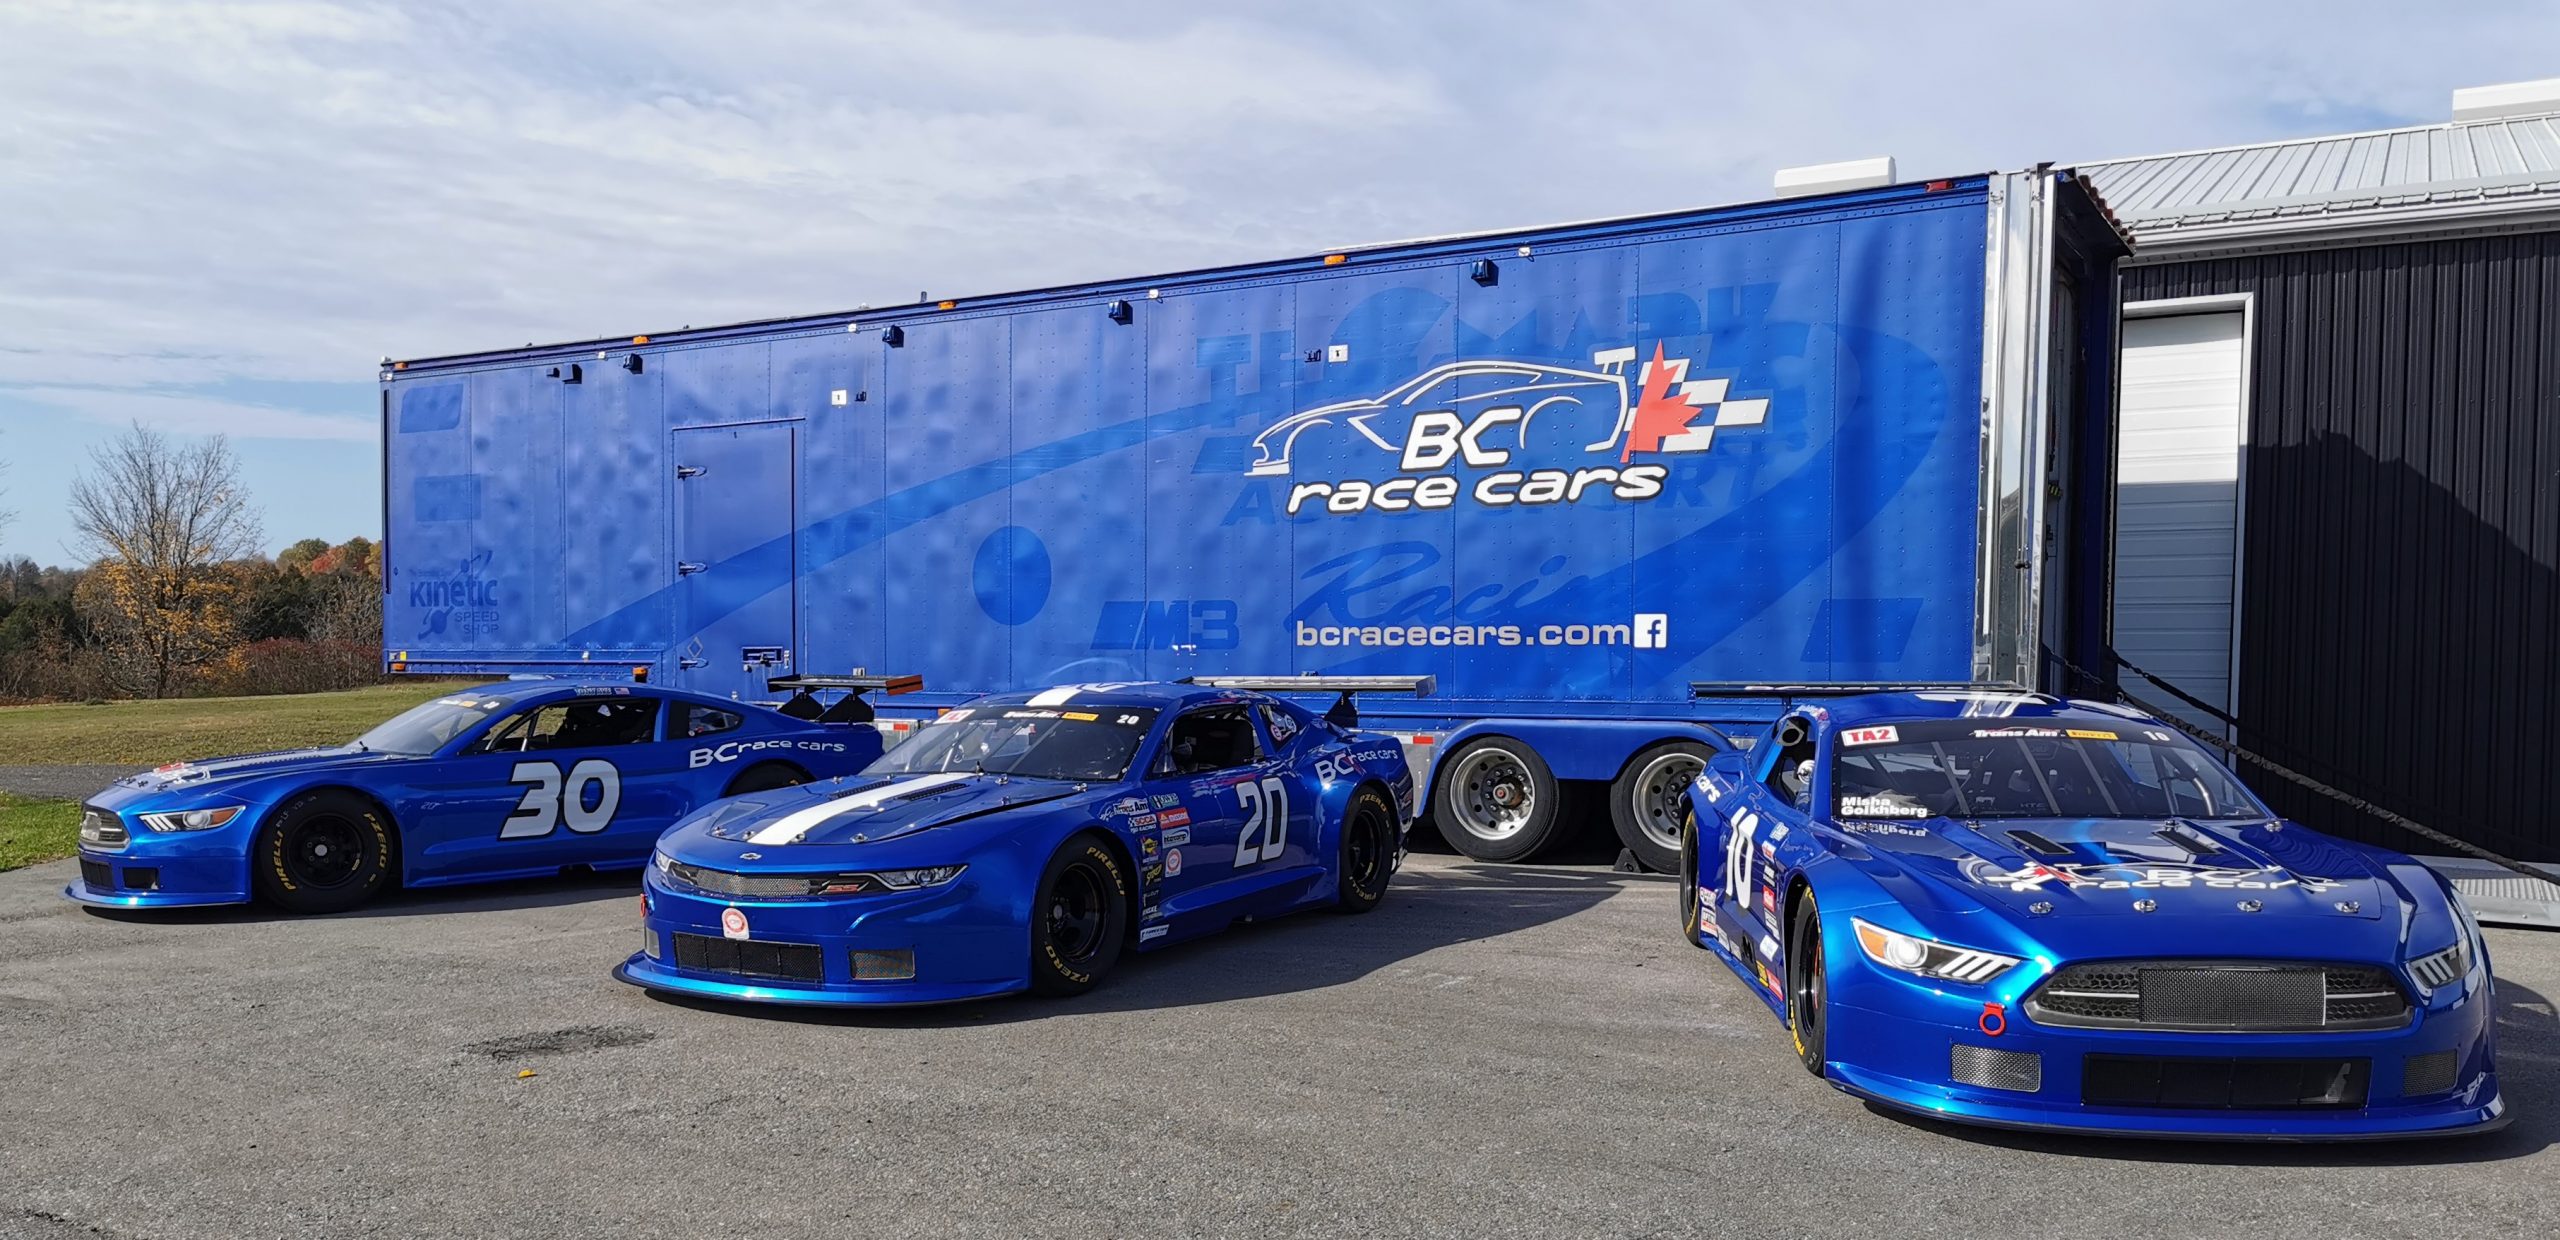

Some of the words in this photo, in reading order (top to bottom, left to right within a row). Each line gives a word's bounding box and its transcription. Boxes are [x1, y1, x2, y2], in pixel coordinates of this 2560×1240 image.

[1401, 407, 1522, 471] BC
[1286, 476, 1459, 514] race
[1474, 464, 1667, 506] cars
[454, 610, 500, 622] SPEED
[463, 624, 500, 634] SHOP
[1296, 619, 1631, 647] bcracecars.com
[1116, 714, 1140, 725] 20
[1973, 728, 2022, 738] Trans
[1848, 729, 1892, 743] TA2
[2143, 730, 2171, 742] 10
[689, 742, 738, 769] BC
[738, 740, 793, 754] race
[797, 740, 845, 752] cars
[1315, 753, 1354, 783] BC
[1348, 749, 1377, 765] race
[1377, 749, 1399, 760] cars
[499, 759, 620, 839] 30
[1134, 800, 1148, 811] Am
[1841, 796, 1891, 807] Misha
[1233, 776, 1289, 868] 20
[273, 830, 297, 890] PIRELLI
[1086, 846, 1125, 896] PIRELLI
[1725, 805, 1759, 909] 10
[1044, 944, 1091, 983] PZERO
